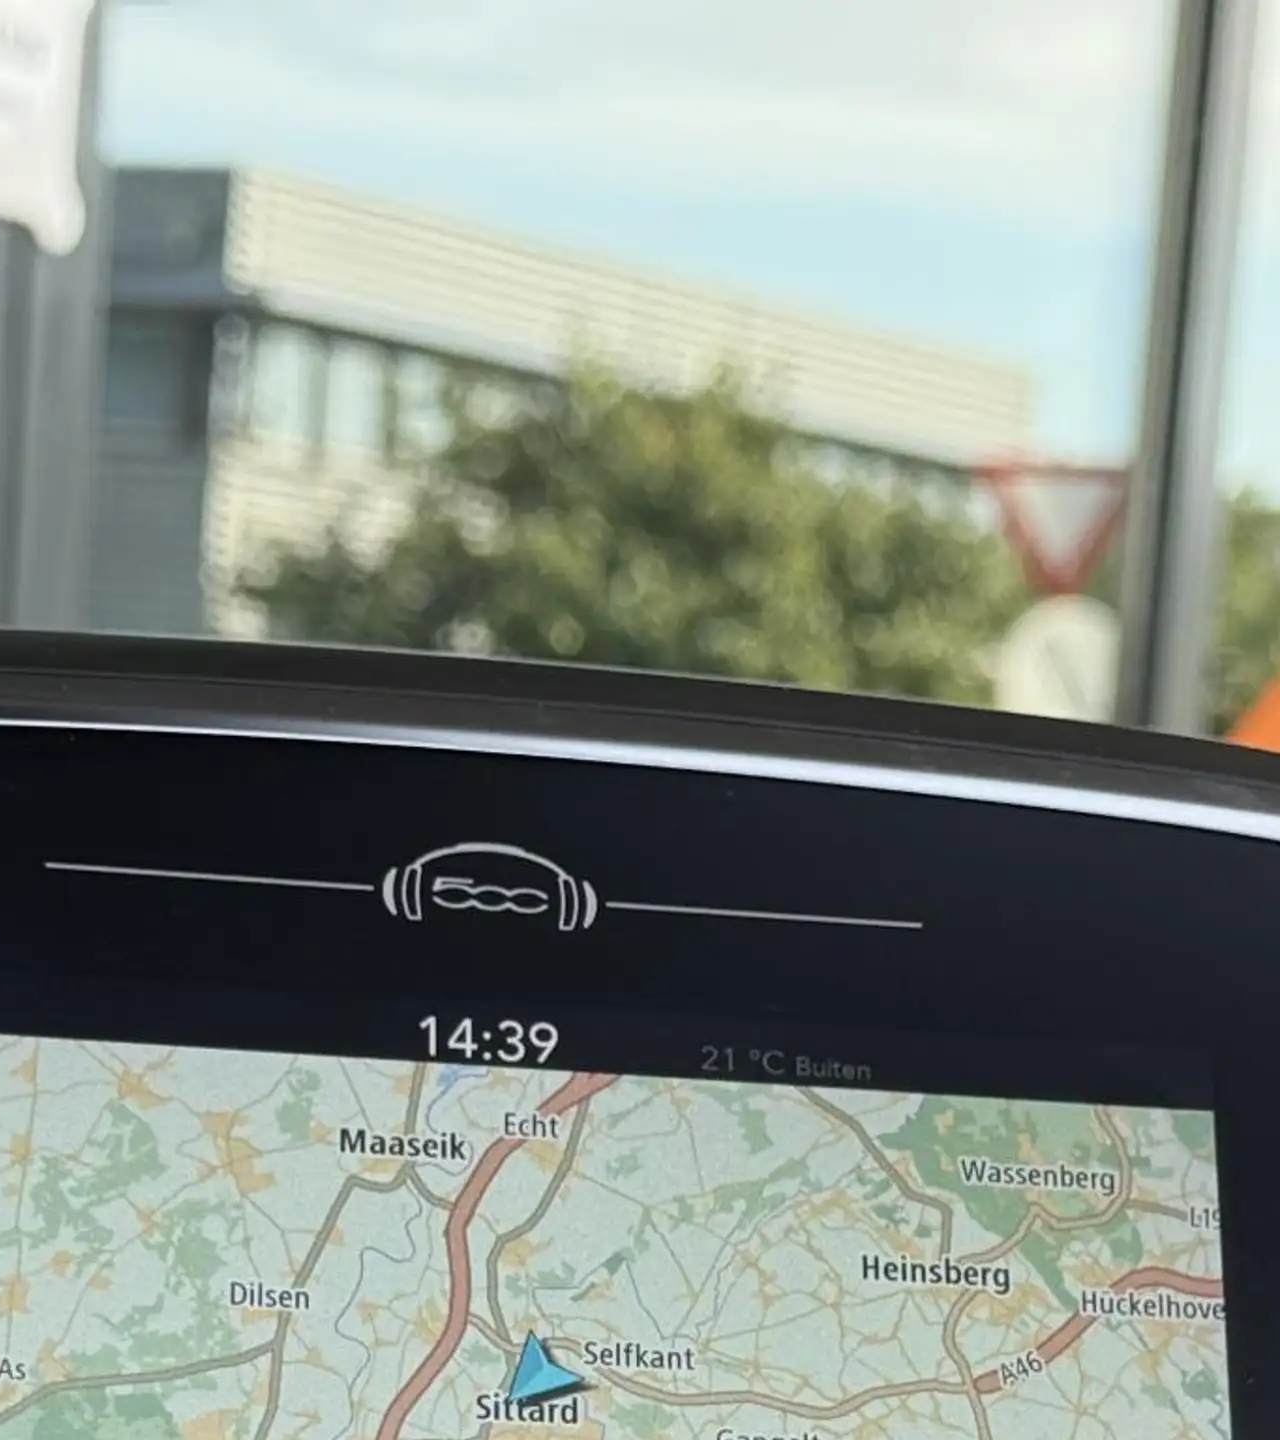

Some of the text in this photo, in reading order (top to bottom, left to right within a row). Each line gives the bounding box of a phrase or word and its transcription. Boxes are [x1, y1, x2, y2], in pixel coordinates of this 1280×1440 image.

[418, 1014, 559, 1064] 14:39
[700, 1045, 736, 1073] 21
[795, 1056, 872, 1081] Buiten
[503, 1112, 560, 1139] Echt
[339, 1128, 468, 1160] Maaseik
[961, 1159, 1116, 1196] Wassenberg
[861, 1254, 1011, 1292] Heinsberg
[230, 1281, 311, 1310] Dilsen
[583, 1341, 696, 1371] Selfkant
[999, 1350, 1043, 1386] A46
[476, 1394, 579, 1425] Sittard
